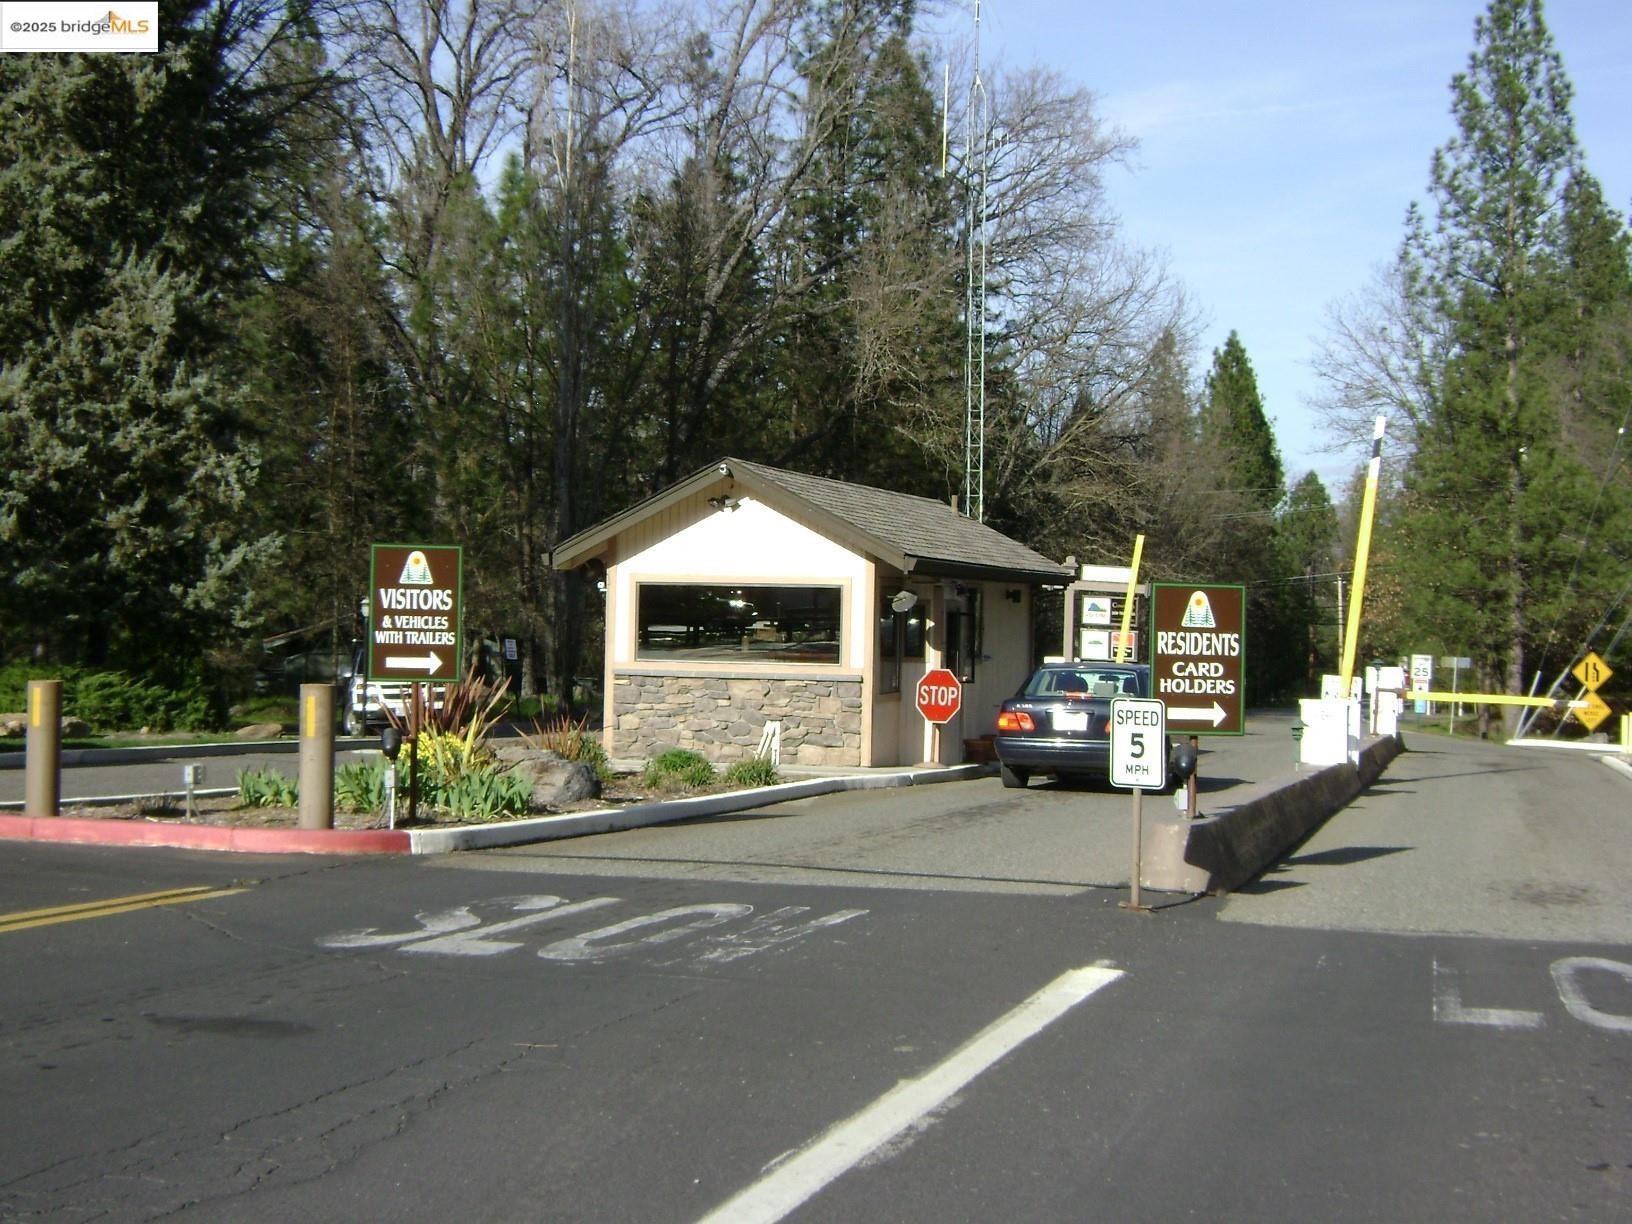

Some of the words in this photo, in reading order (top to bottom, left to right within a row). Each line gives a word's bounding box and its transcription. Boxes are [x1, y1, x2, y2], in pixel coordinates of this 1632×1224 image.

[380, 588, 452, 610] VISITORS
[382, 615, 392, 628] &
[395, 615, 448, 629] VEHICLES
[375, 631, 402, 644] WITH
[405, 631, 455, 645] TRAILERS
[1157, 632, 1239, 656] RESIDENTS
[1172, 661, 1223, 677] CARD
[1414, 668, 1429, 677] 25
[1160, 679, 1235, 694] HOLDERS
[920, 685, 957, 706] STOP
[1117, 710, 1159, 726] SPEED
[1130, 733, 1145, 758] 5
[1126, 765, 1149, 775] MPH
